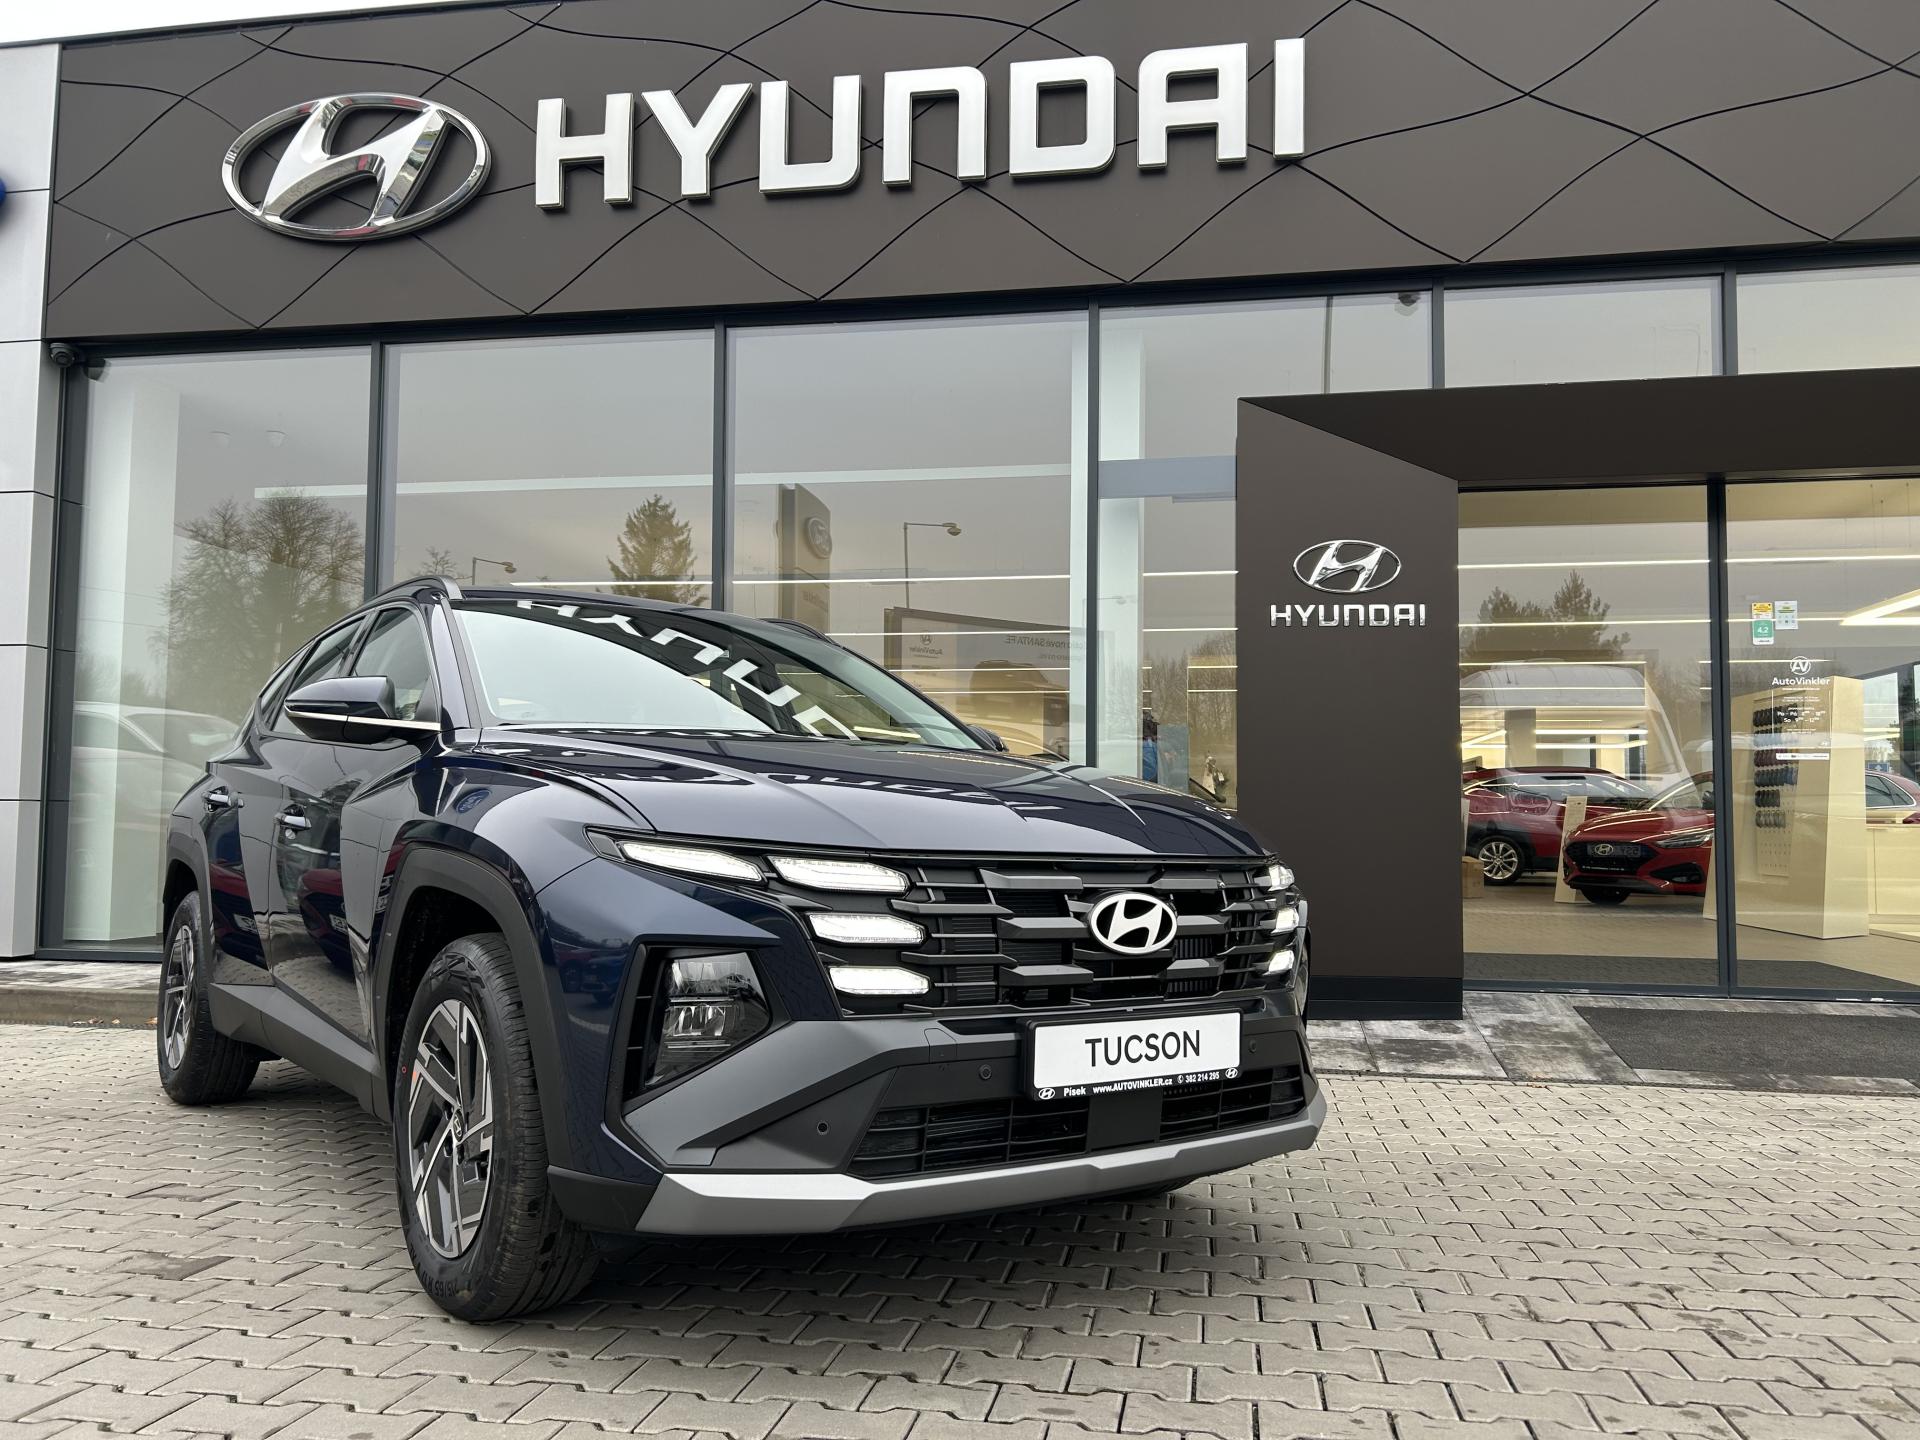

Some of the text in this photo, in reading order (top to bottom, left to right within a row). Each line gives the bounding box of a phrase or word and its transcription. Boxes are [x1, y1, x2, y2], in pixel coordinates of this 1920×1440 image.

[535, 38, 1305, 209] HYUNDAI
[1270, 603, 1426, 627] HYUNDAI
[1771, 676, 1831, 686] AutoVinkler
[1084, 1030, 1200, 1067] TUCSON
[1092, 1078, 1173, 1093] www.AUTOVINKLER.cz
[1185, 1074, 1197, 1083] 382
[1197, 1073, 1208, 1082] 214
